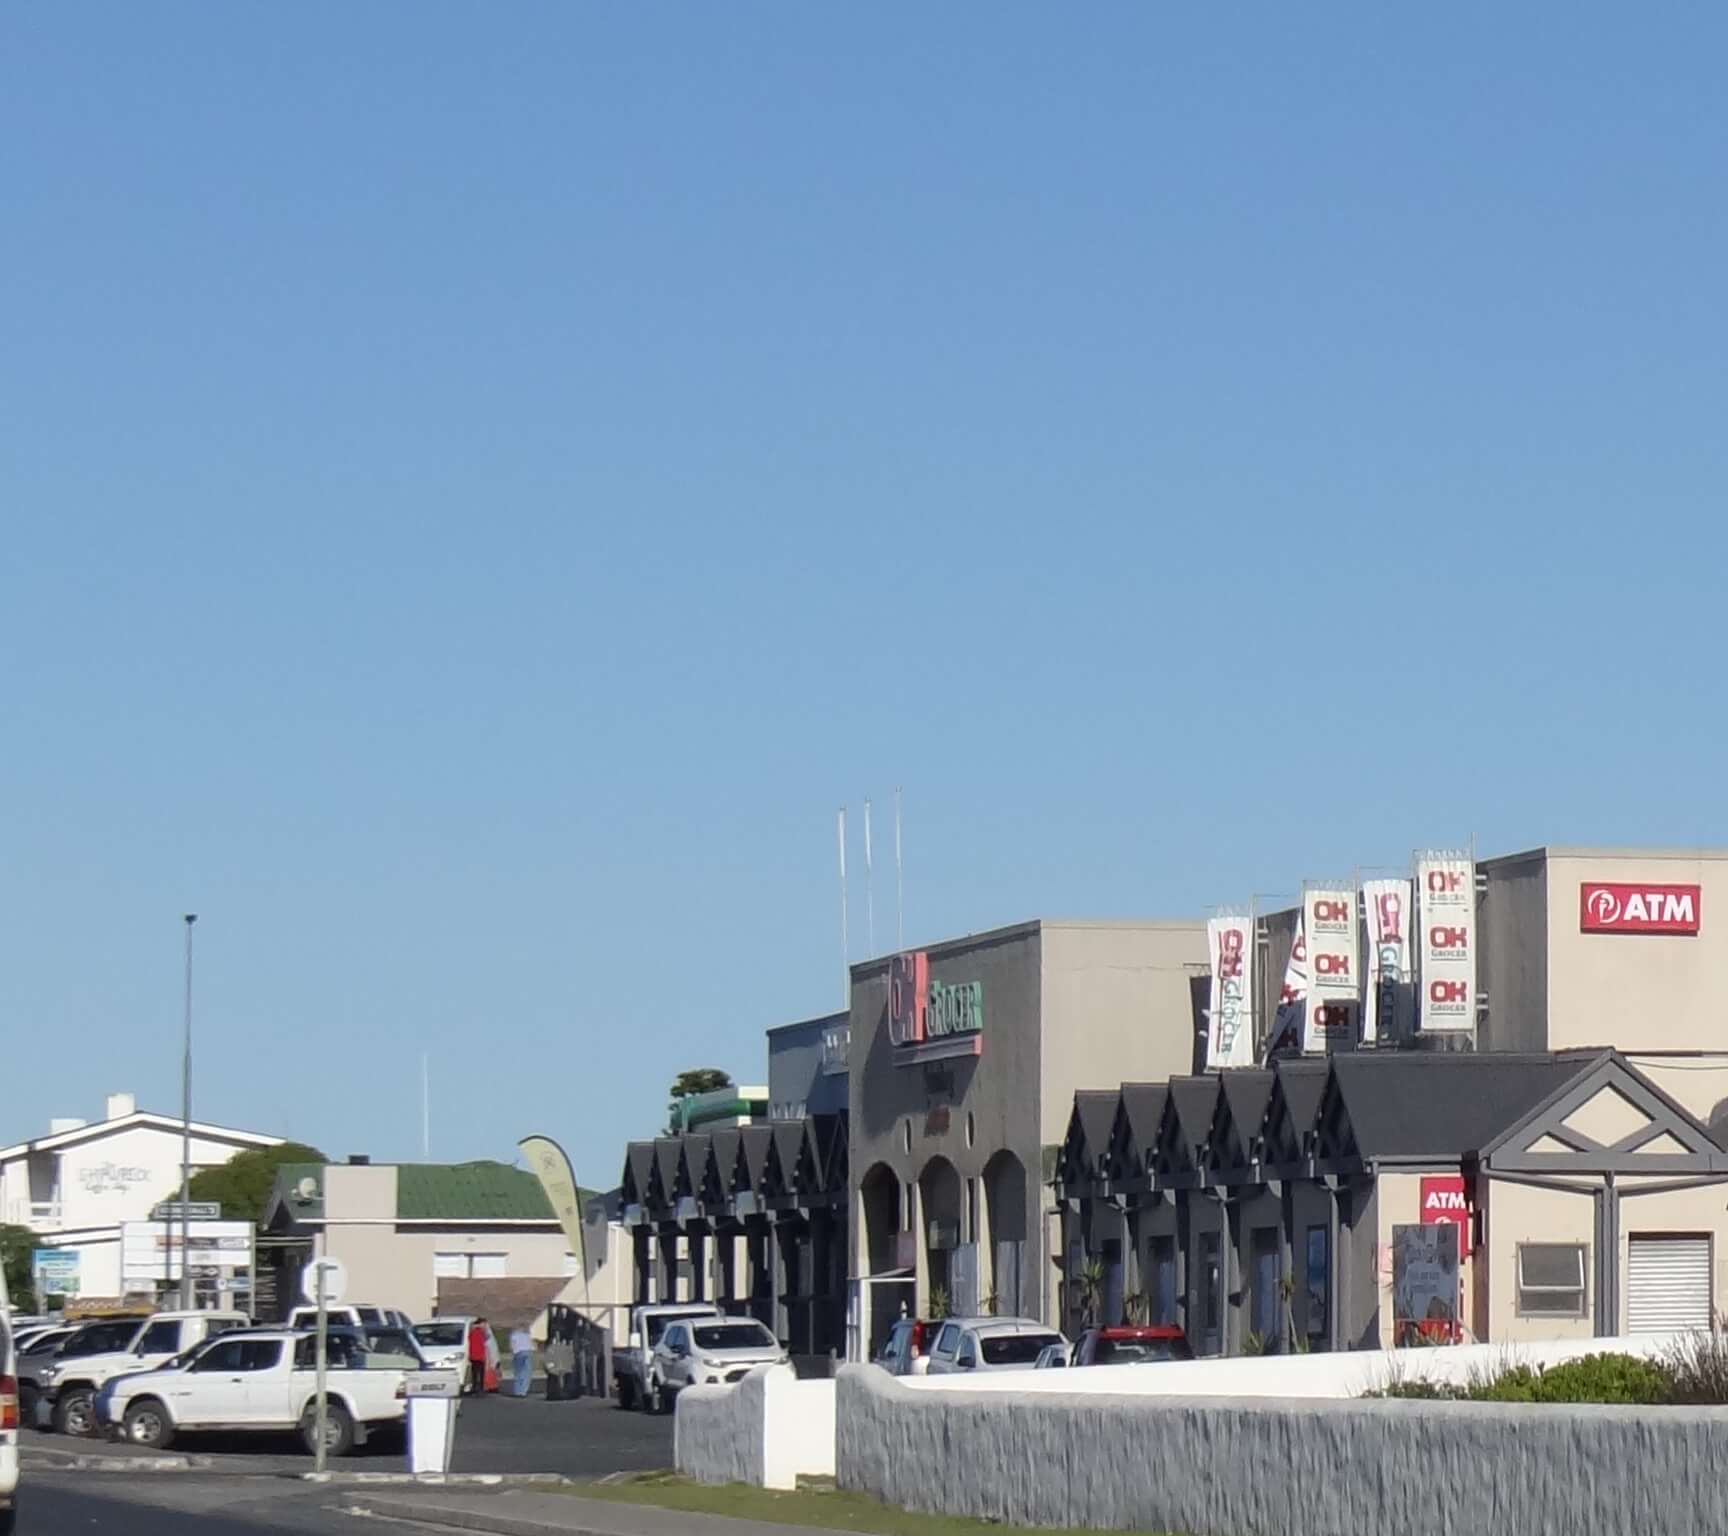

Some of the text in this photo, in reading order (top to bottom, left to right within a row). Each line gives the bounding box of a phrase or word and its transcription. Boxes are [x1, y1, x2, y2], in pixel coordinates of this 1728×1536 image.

[1314, 900, 1349, 921] OK
[1623, 893, 1694, 922] ATM
[1430, 927, 1467, 948] OK
[1223, 929, 1243, 976] OK
[1314, 954, 1350, 974] OK
[1430, 981, 1467, 1002] OK
[926, 979, 983, 1037] GROCER
[1314, 1005, 1350, 1026] OK
[1425, 1191, 1466, 1209] ATM
